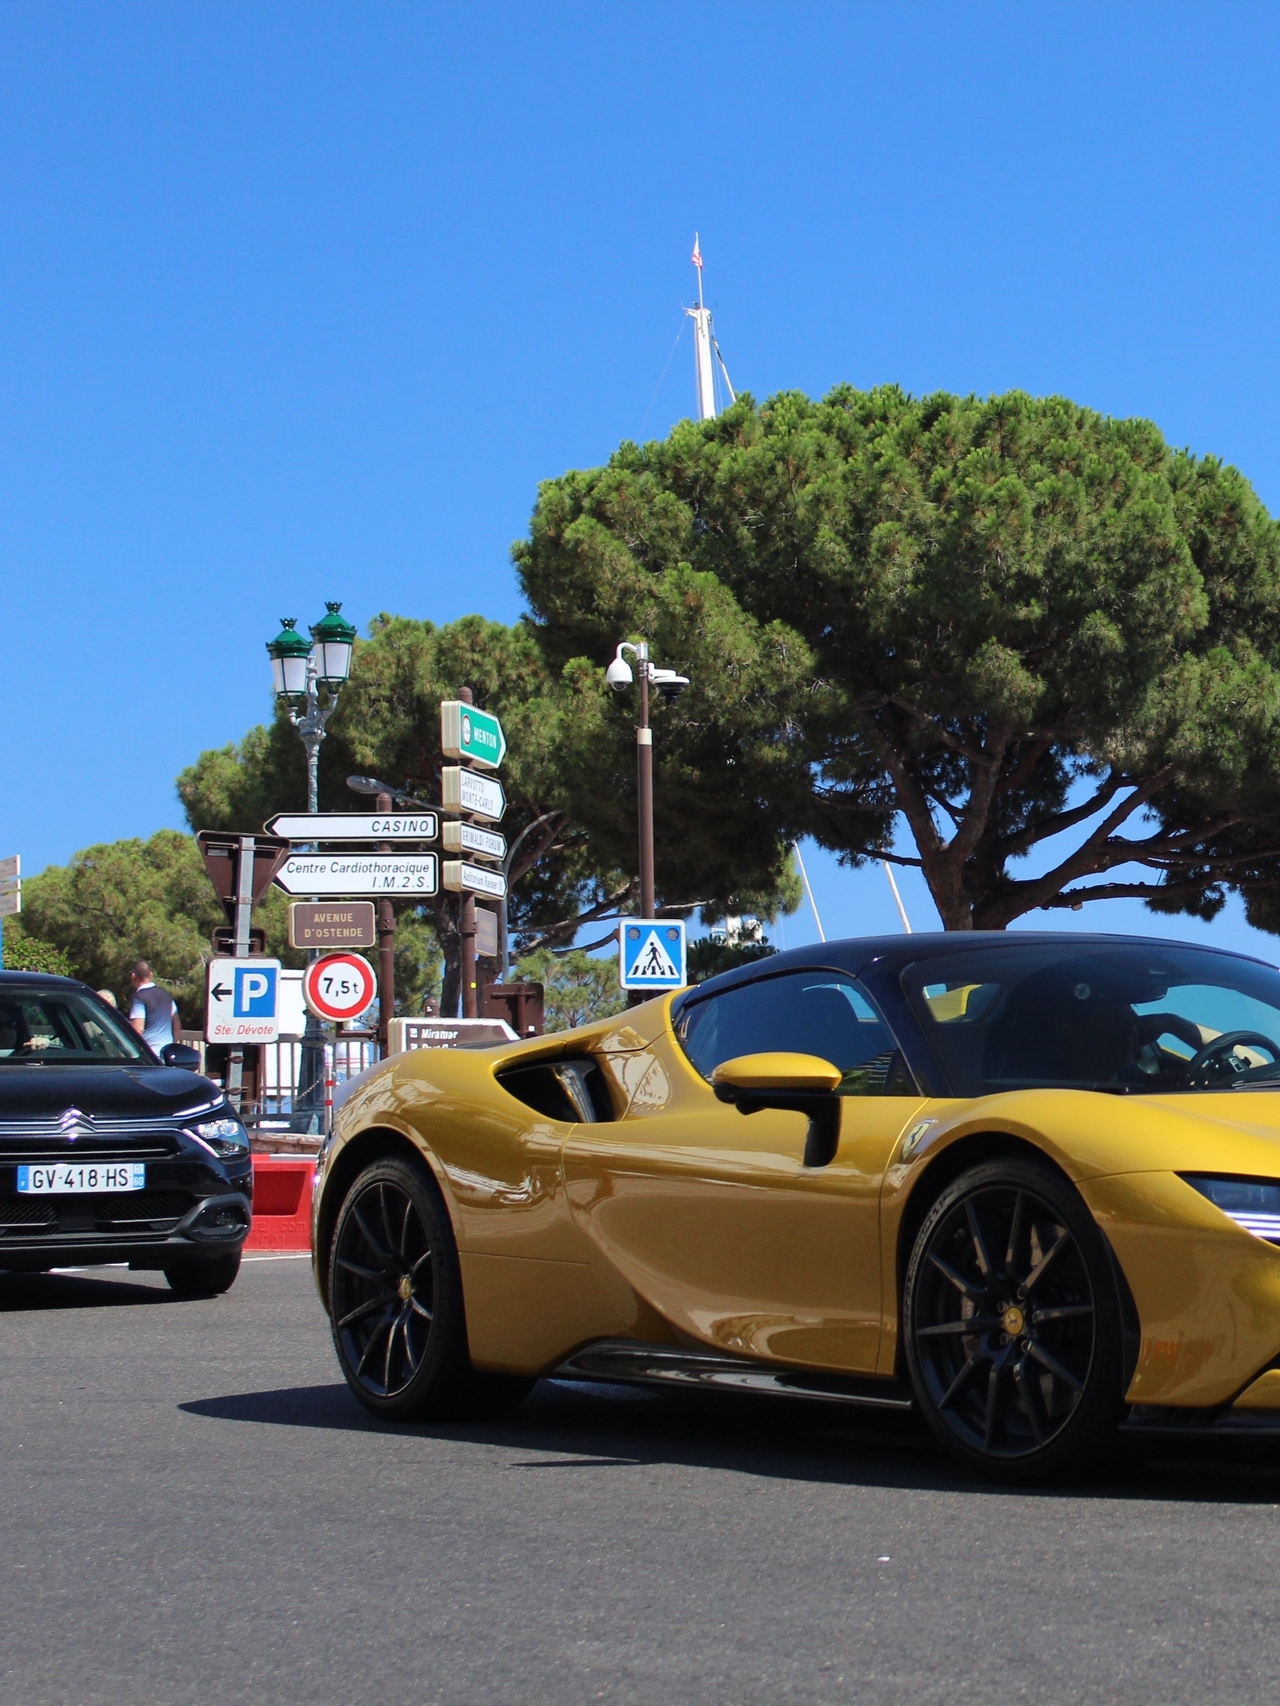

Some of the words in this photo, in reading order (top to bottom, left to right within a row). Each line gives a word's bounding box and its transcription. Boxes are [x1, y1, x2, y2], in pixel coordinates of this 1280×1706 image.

[473, 726, 497, 749] MENTON
[462, 774, 485, 793] LARVOTTO
[462, 789, 494, 811] MONTE-CARLO
[371, 820, 429, 832] CASINO
[462, 829, 484, 847] GRIMALDI
[485, 836, 502, 852] FORUM
[286, 861, 326, 874] Centre
[330, 861, 430, 876] Cardiothoracique
[372, 876, 430, 888] I.M.2.S.
[313, 913, 354, 923] AVENUE
[304, 928, 364, 938] D'OSTENDE
[241, 973, 269, 1012] P
[237, 1024, 274, 1035] Dévote
[421, 1028, 459, 1039] Miramar
[32, 1168, 129, 1188] GV-418-HS
[133, 1176, 144, 1186] 60
